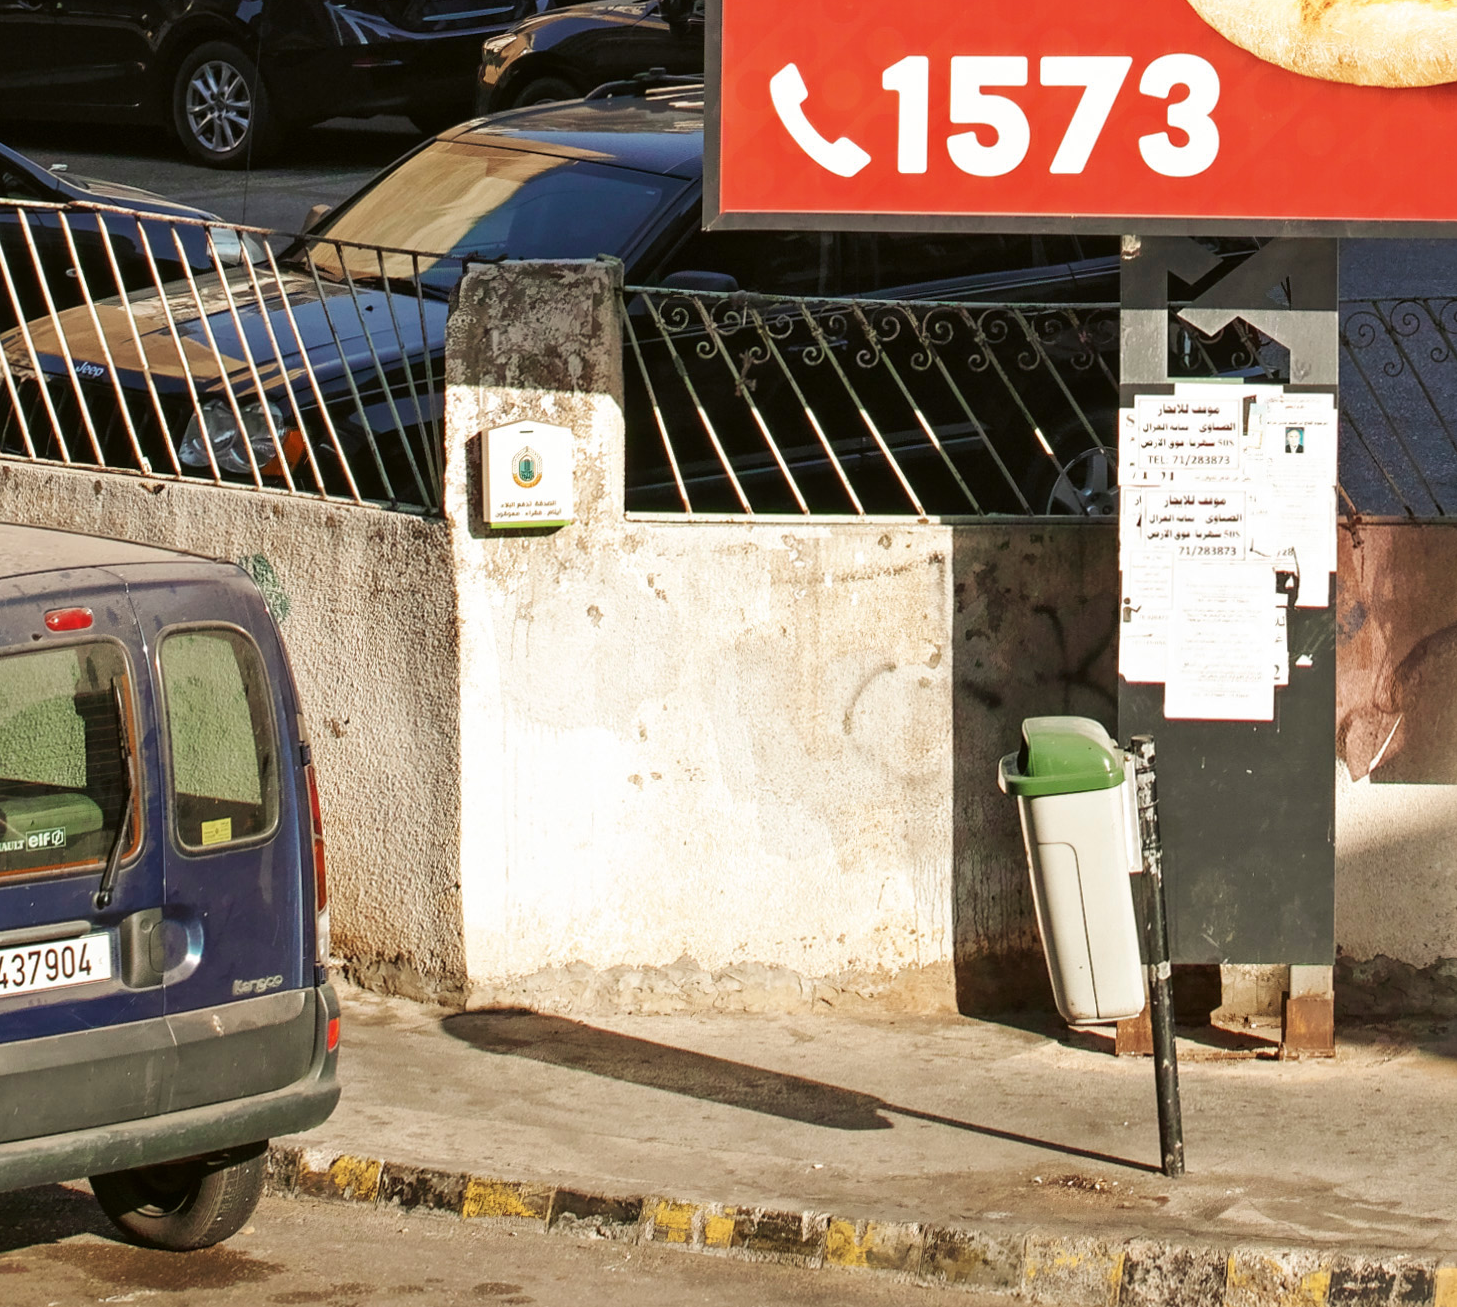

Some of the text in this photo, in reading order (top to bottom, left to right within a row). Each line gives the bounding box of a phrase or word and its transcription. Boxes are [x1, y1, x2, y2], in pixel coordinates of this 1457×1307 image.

[882, 53, 1221, 177] 1573
[75, 361, 105, 378] Jeep
[1172, 454, 1232, 468] 71/283873
[1177, 545, 1239, 558] 71/283873
[28, 831, 52, 848] elf
